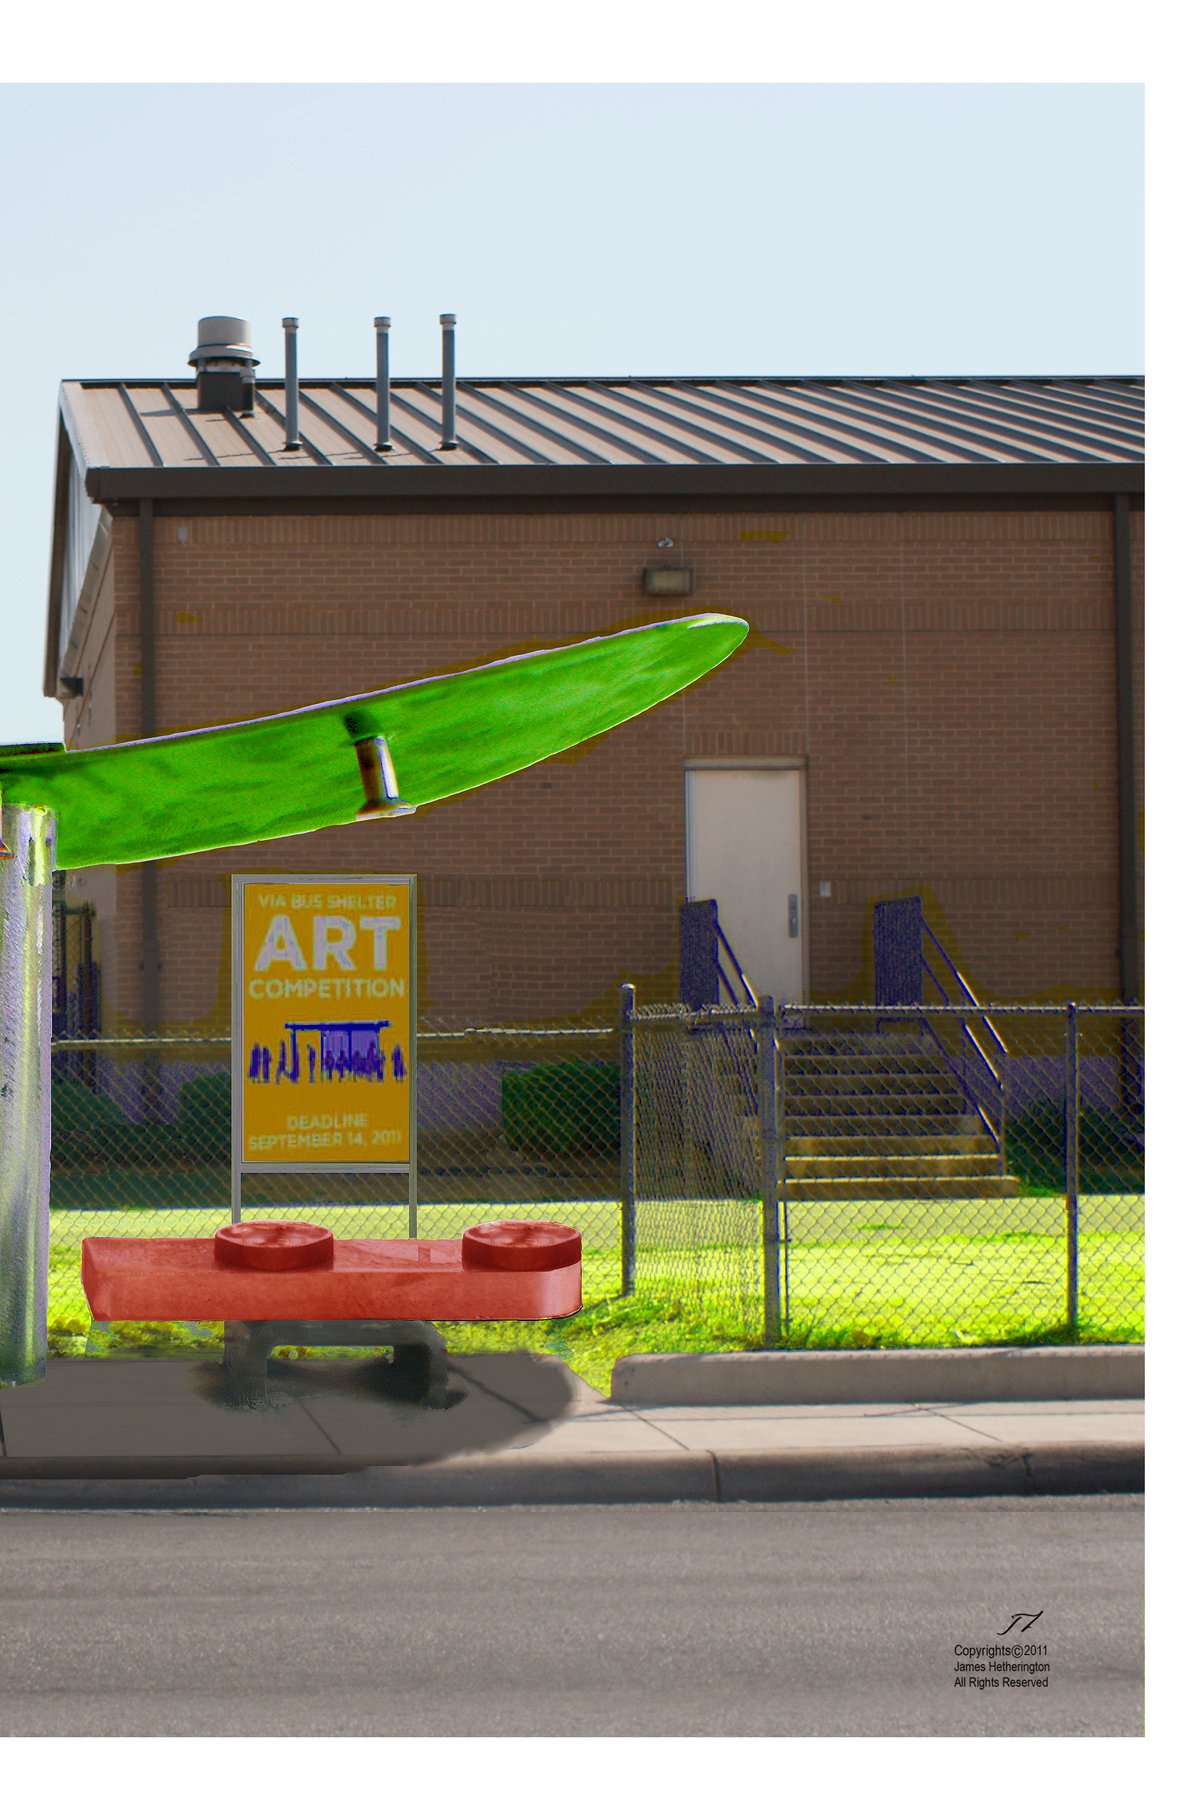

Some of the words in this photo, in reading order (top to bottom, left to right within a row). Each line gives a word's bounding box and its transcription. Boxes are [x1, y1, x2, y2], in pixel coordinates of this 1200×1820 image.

[258, 894, 286, 909] VIA
[292, 894, 322, 910] BUS
[328, 895, 396, 911] SHELTER
[254, 915, 402, 972] ART
[249, 977, 406, 999] COMPETITION
[287, 1113, 368, 1131] DEADLINE
[248, 1133, 342, 1152] SEPTEMBER
[372, 1129, 402, 1146] 2011
